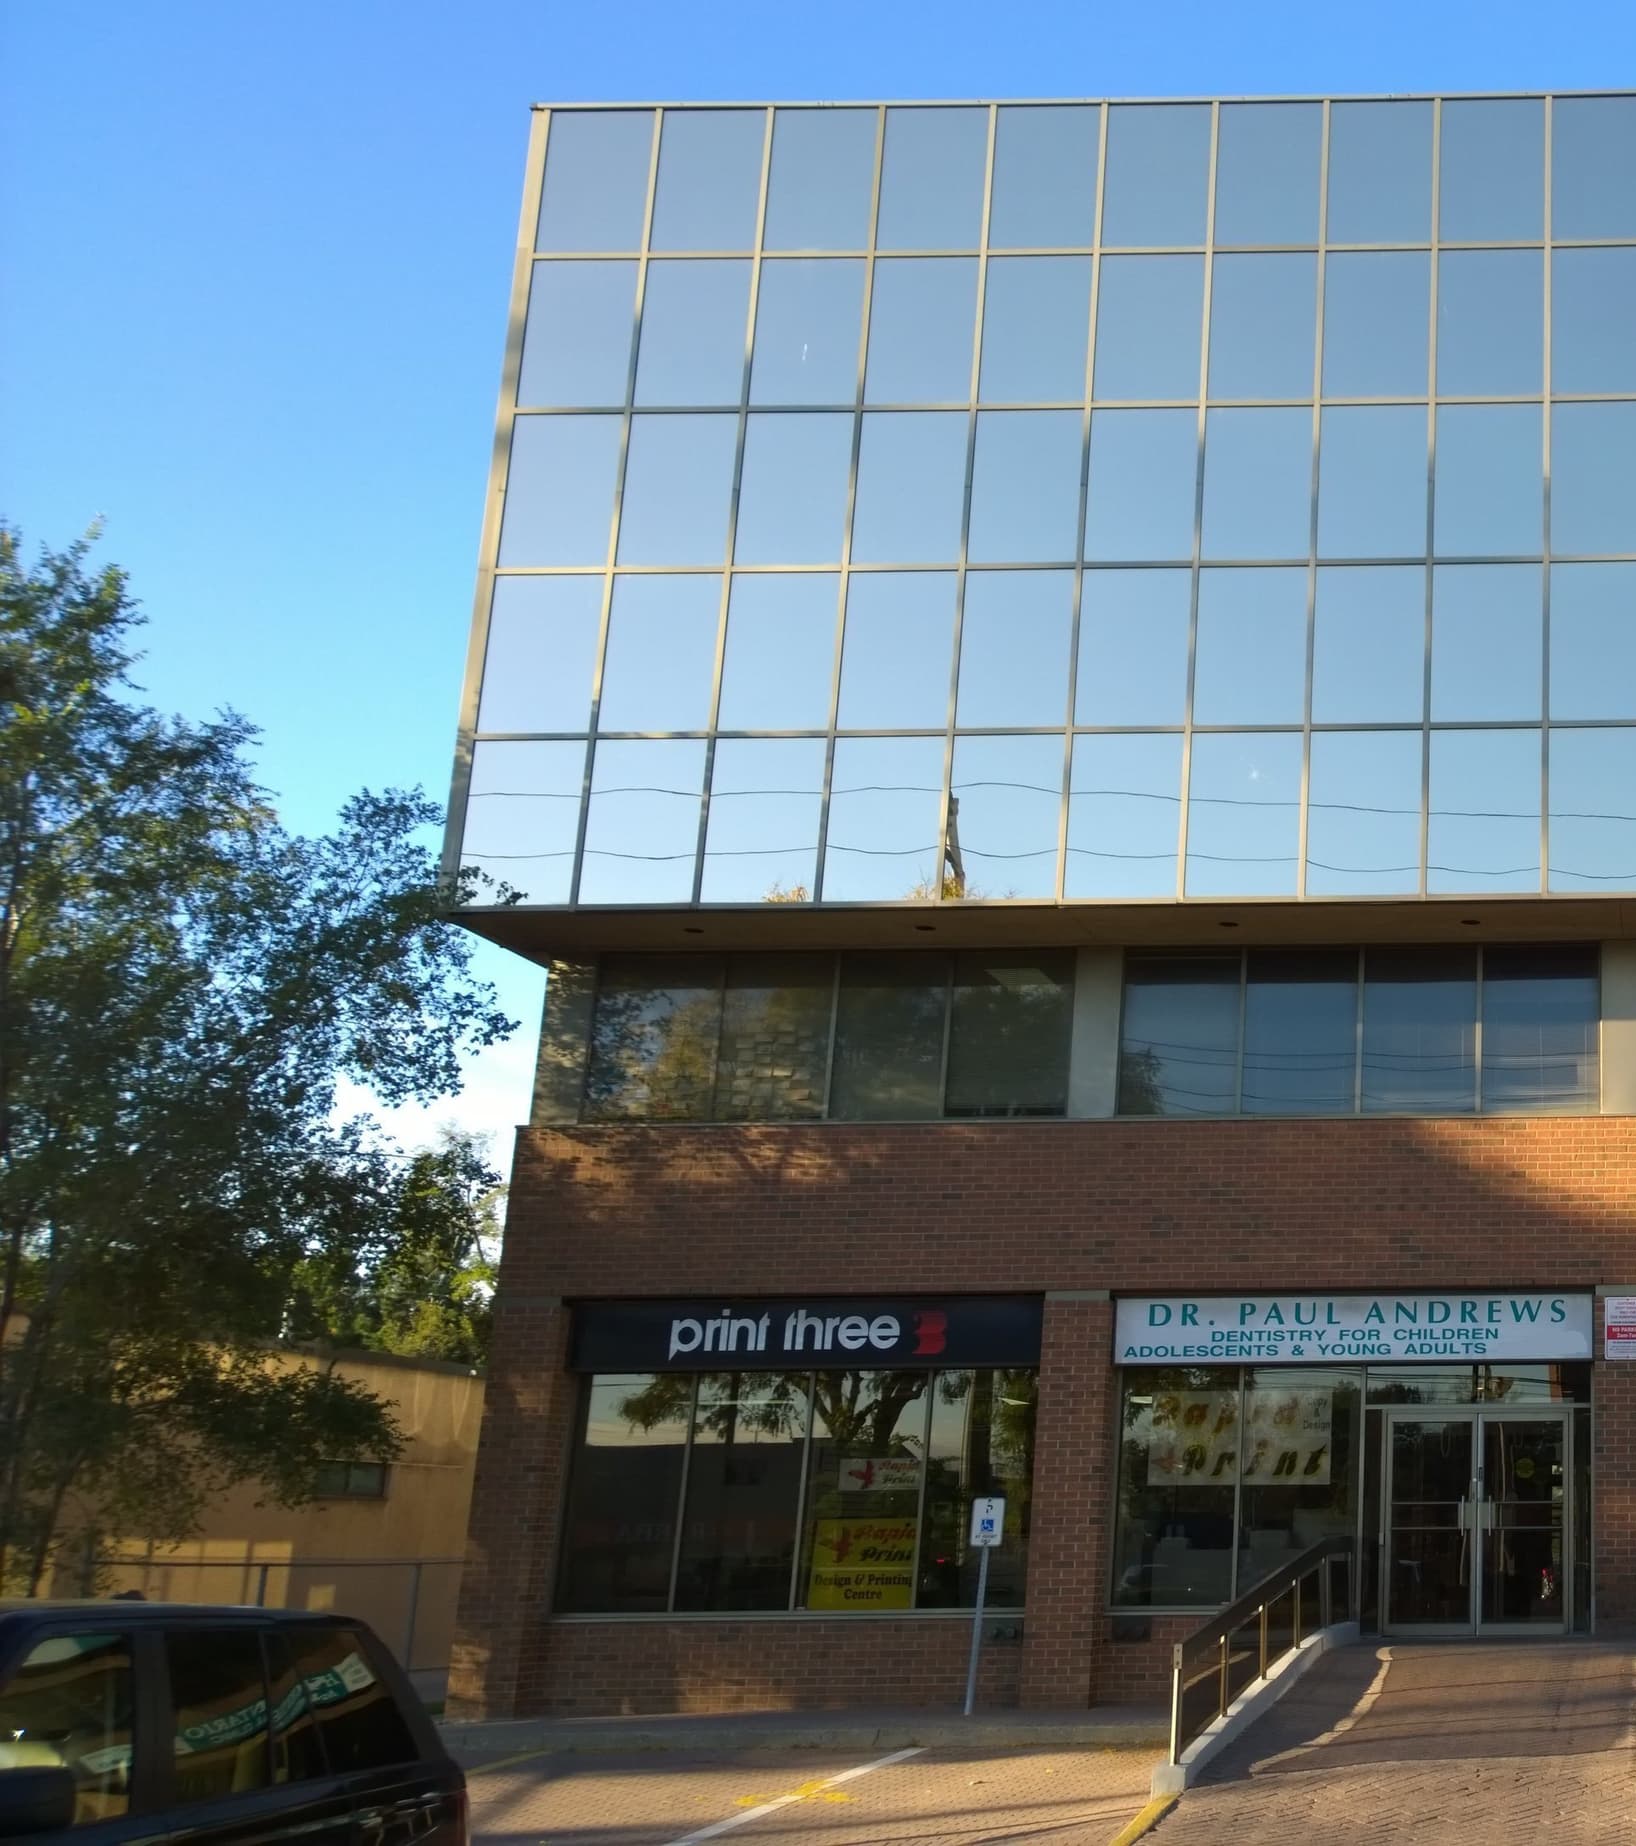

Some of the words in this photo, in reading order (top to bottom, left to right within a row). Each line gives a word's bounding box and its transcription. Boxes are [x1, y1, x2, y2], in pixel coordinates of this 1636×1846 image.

[1148, 1303, 1215, 1327] DR.
[1239, 1302, 1340, 1326] PAUL
[1364, 1299, 1567, 1324] ANDREWS
[668, 1308, 771, 1361] print
[783, 1309, 901, 1352] three
[1211, 1329, 1327, 1343] DENTISTRY
[1339, 1329, 1381, 1341] FOR
[1393, 1328, 1499, 1341] CHILDREN
[1124, 1344, 1279, 1358] ADOLESCENTS
[1291, 1344, 1305, 1356] &
[1318, 1343, 1391, 1356] YOUNG
[1404, 1342, 1487, 1355] ADULTS
